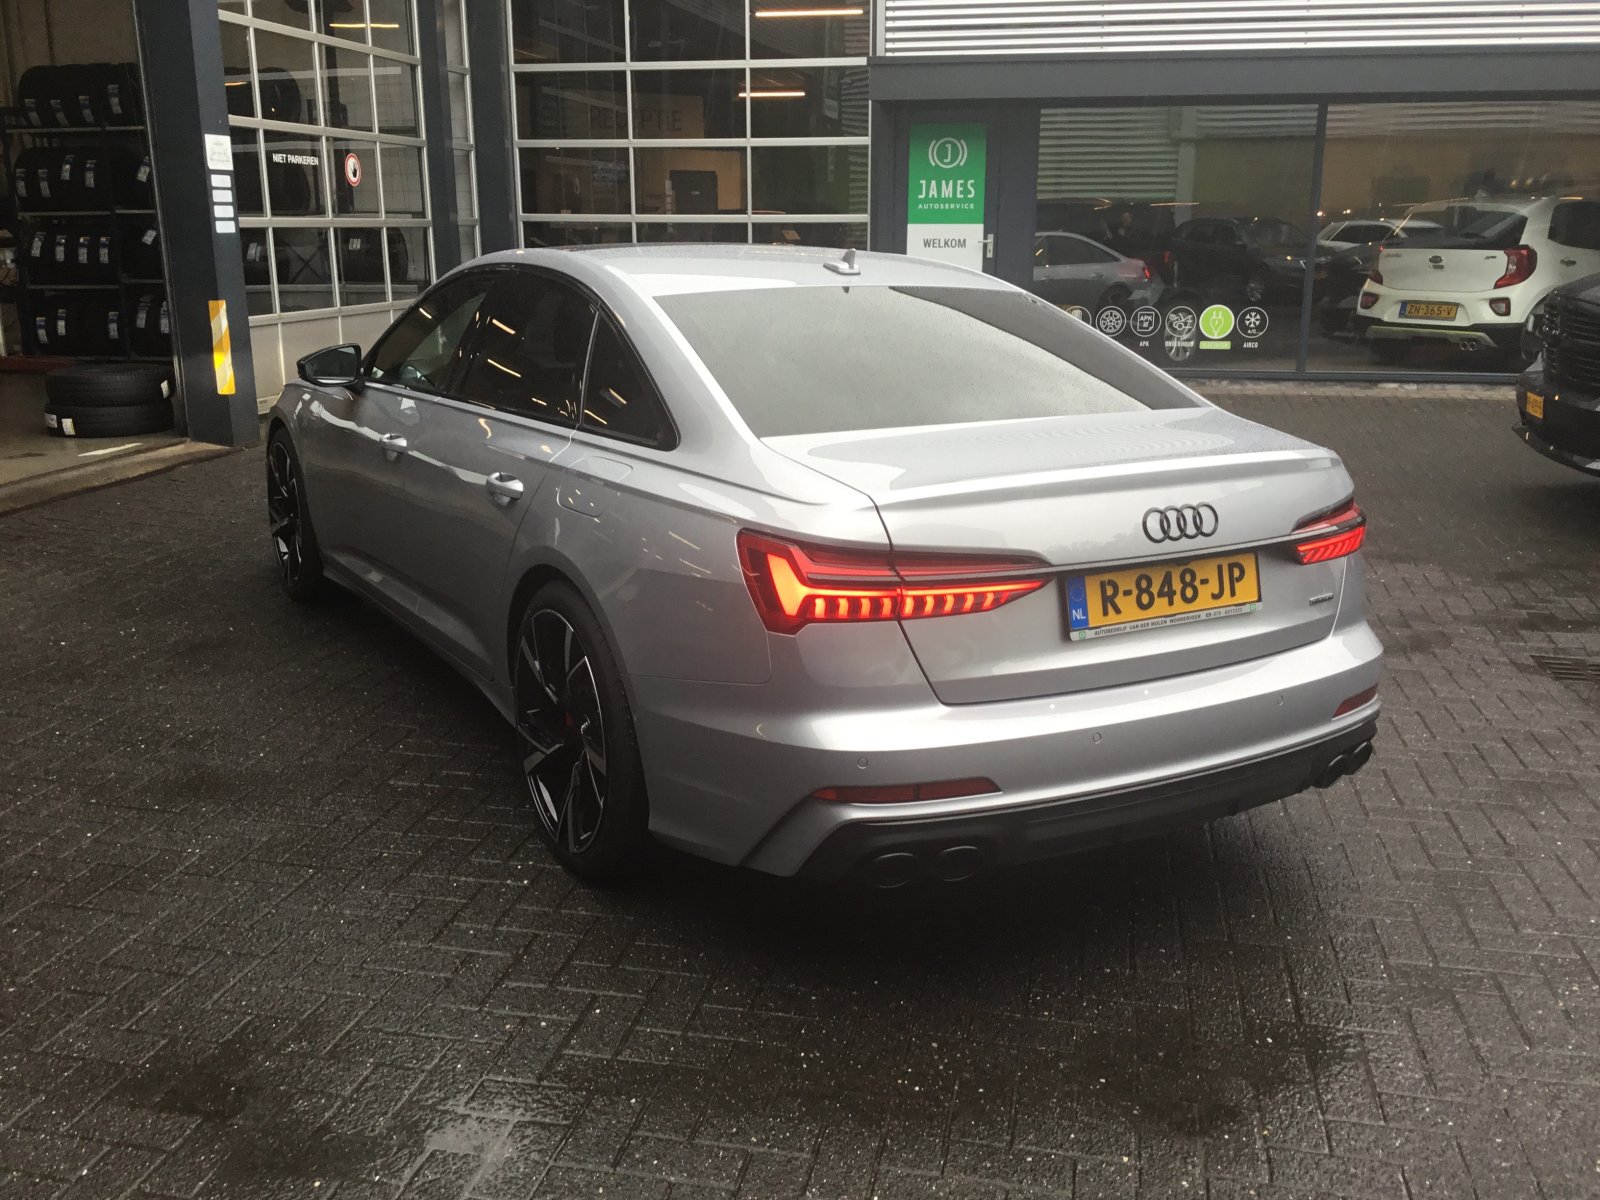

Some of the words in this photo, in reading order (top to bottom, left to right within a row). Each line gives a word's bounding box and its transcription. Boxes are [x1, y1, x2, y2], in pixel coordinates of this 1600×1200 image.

[272, 152, 287, 164] NIET
[287, 154, 319, 166] PARKEREN
[917, 179, 975, 199] JAMES
[922, 237, 967, 249] WELKOM
[1100, 561, 1246, 617] R-848-JP
[1072, 607, 1087, 621] NL
